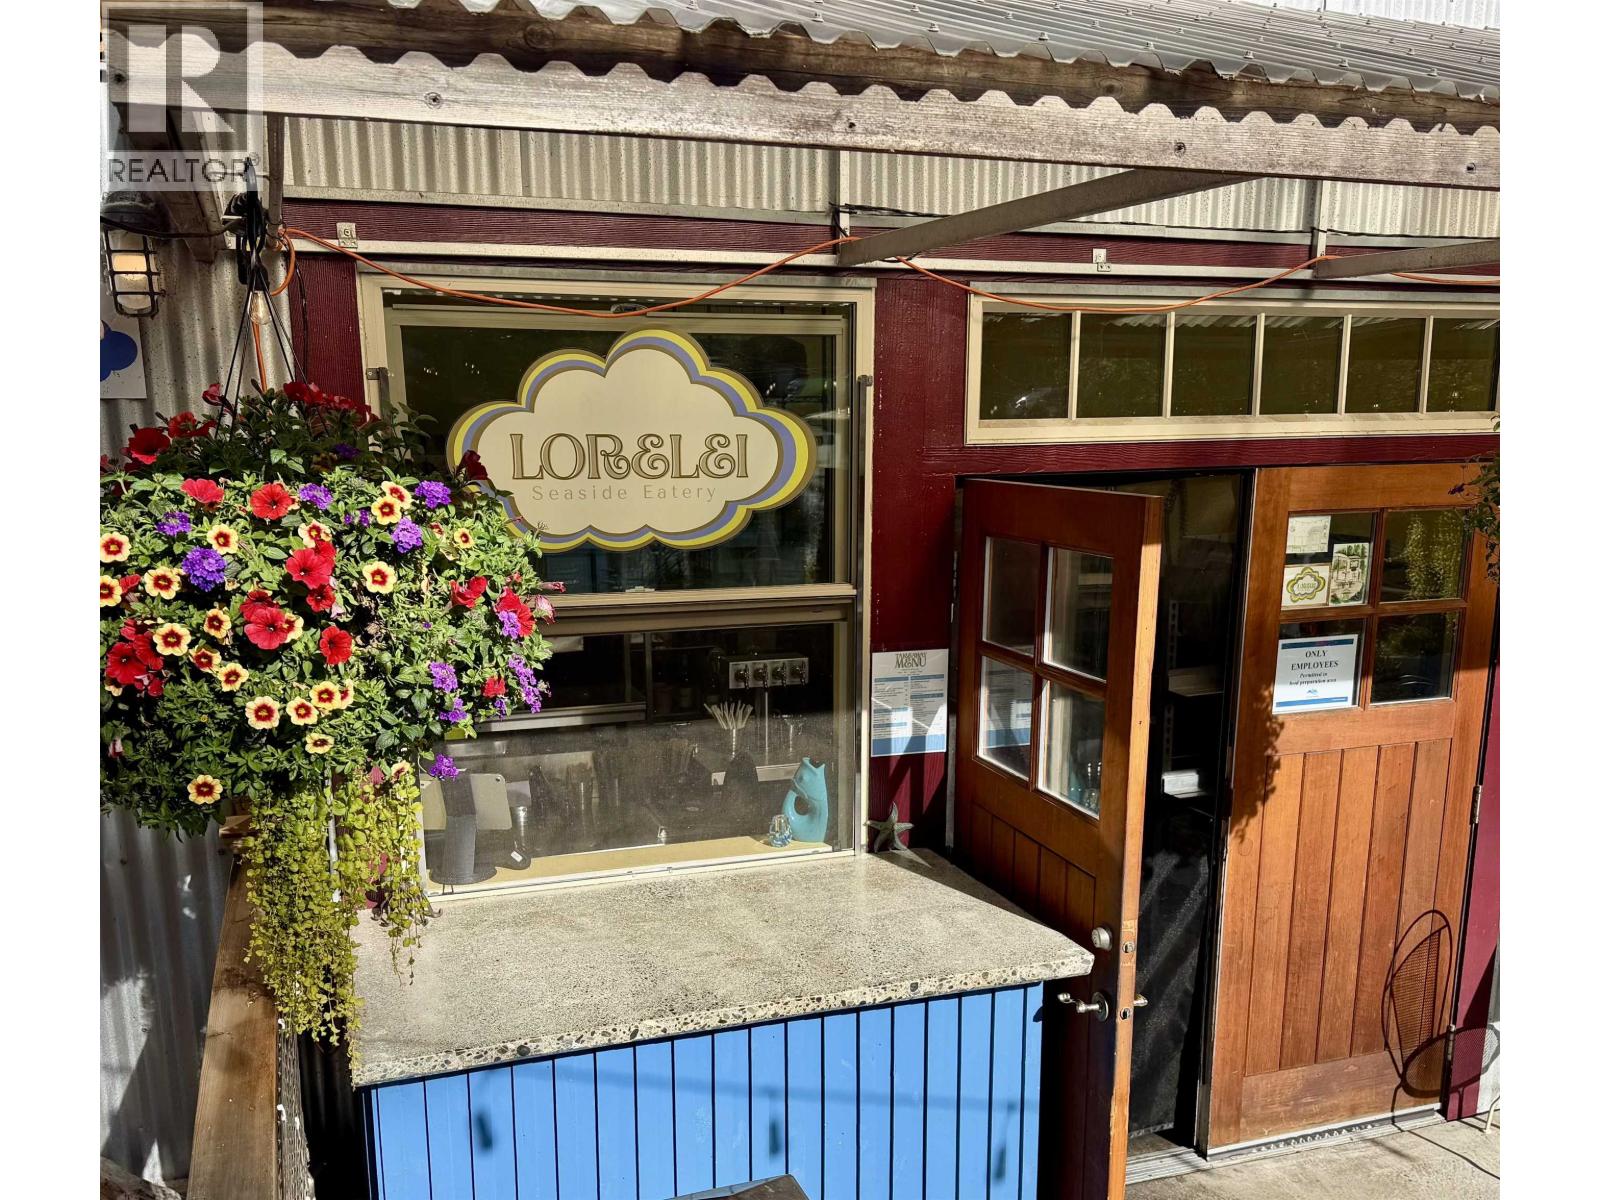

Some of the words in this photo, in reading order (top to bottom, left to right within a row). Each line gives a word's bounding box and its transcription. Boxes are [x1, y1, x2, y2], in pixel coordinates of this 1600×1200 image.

[510, 433, 749, 480] LORELEI
[531, 485, 629, 501] Seaside
[643, 484, 716, 503] Eatery
[1305, 650, 1328, 658] ONLY
[895, 656, 927, 669] MENU
[1291, 660, 1338, 670] EMPLOYEES
